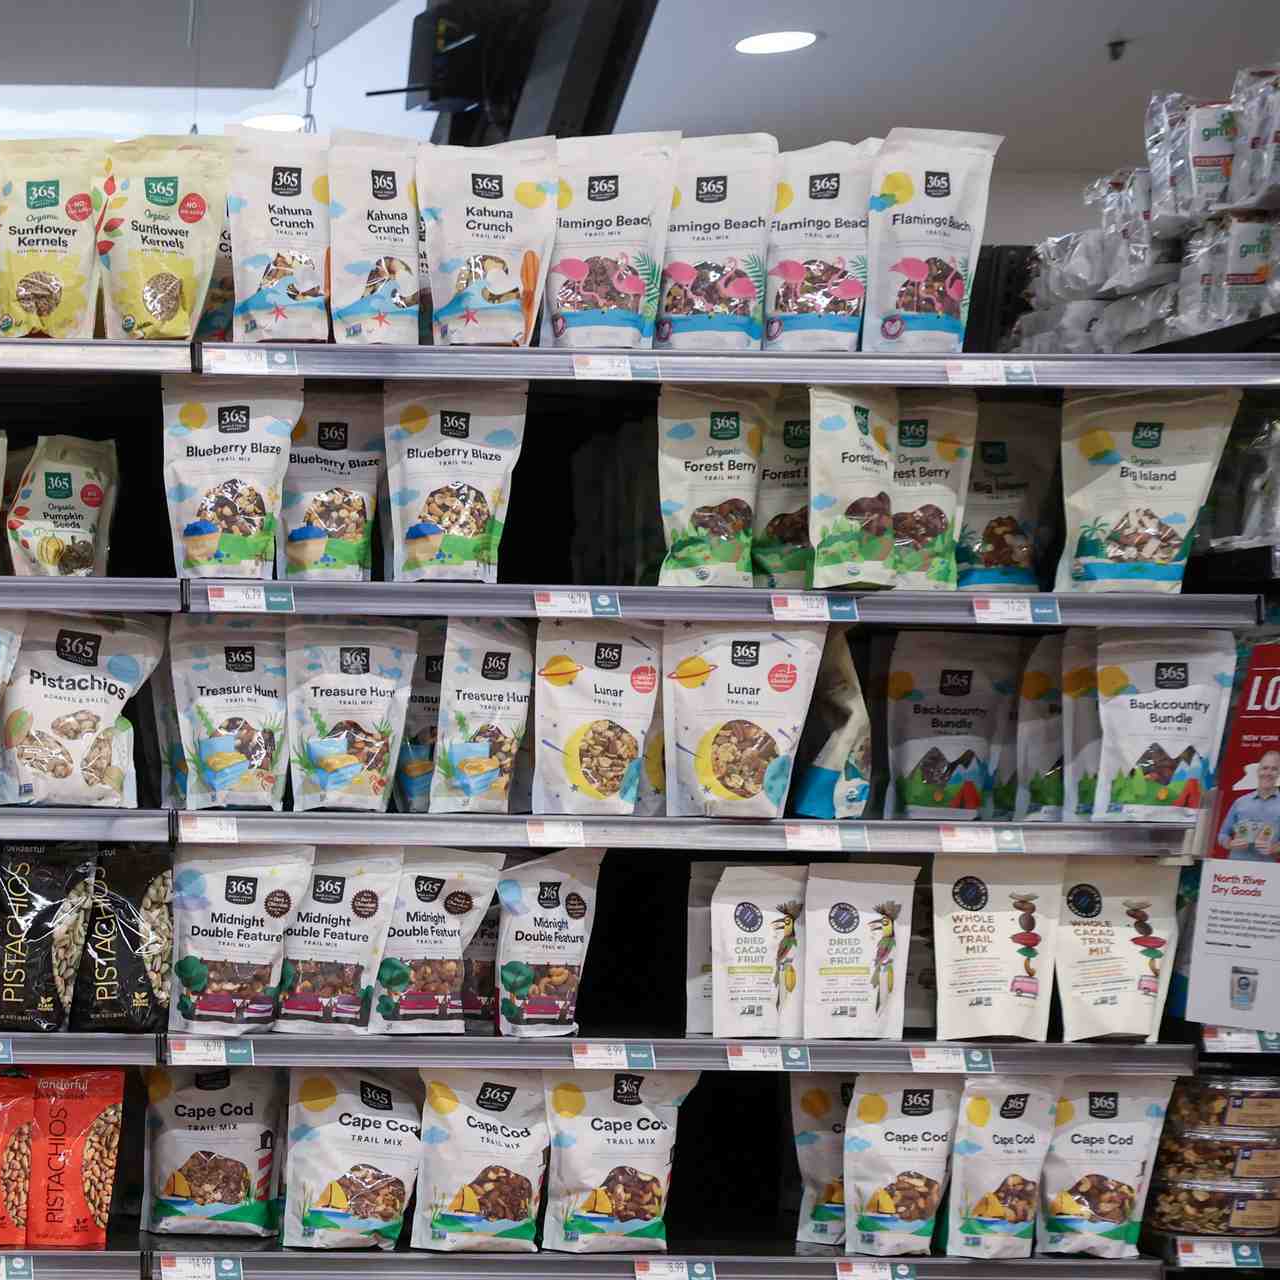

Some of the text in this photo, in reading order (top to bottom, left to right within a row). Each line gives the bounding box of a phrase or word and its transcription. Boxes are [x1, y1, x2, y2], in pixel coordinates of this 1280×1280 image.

[700, 180, 725, 194] 365
[268, 204, 312, 218] Kahuna
[270, 216, 314, 230] Crunch
[8, 224, 77, 239] Sunflower
[18, 236, 68, 249] Kernels
[186, 442, 282, 458] Blueberry Blaze
[684, 460, 757, 476] Forest Berry
[229, 650, 254, 665] 365
[197, 686, 278, 697] Treasure Hunt
[727, 684, 760, 696] Lunar
[1130, 700, 1210, 715] Backcountry
[1150, 712, 1193, 724] Bundle
[229, 880, 254, 895] 365
[211, 914, 264, 928] Midnight
[952, 915, 994, 924] WHOLE
[191, 926, 282, 943] Double Feature
[953, 924, 996, 934] CACAO
[957, 935, 993, 944] TRAIL
[966, 944, 989, 953] MIX
[174, 1102, 253, 1119] Cape Cod
[1071, 1133, 1133, 1148] Cape Cod
